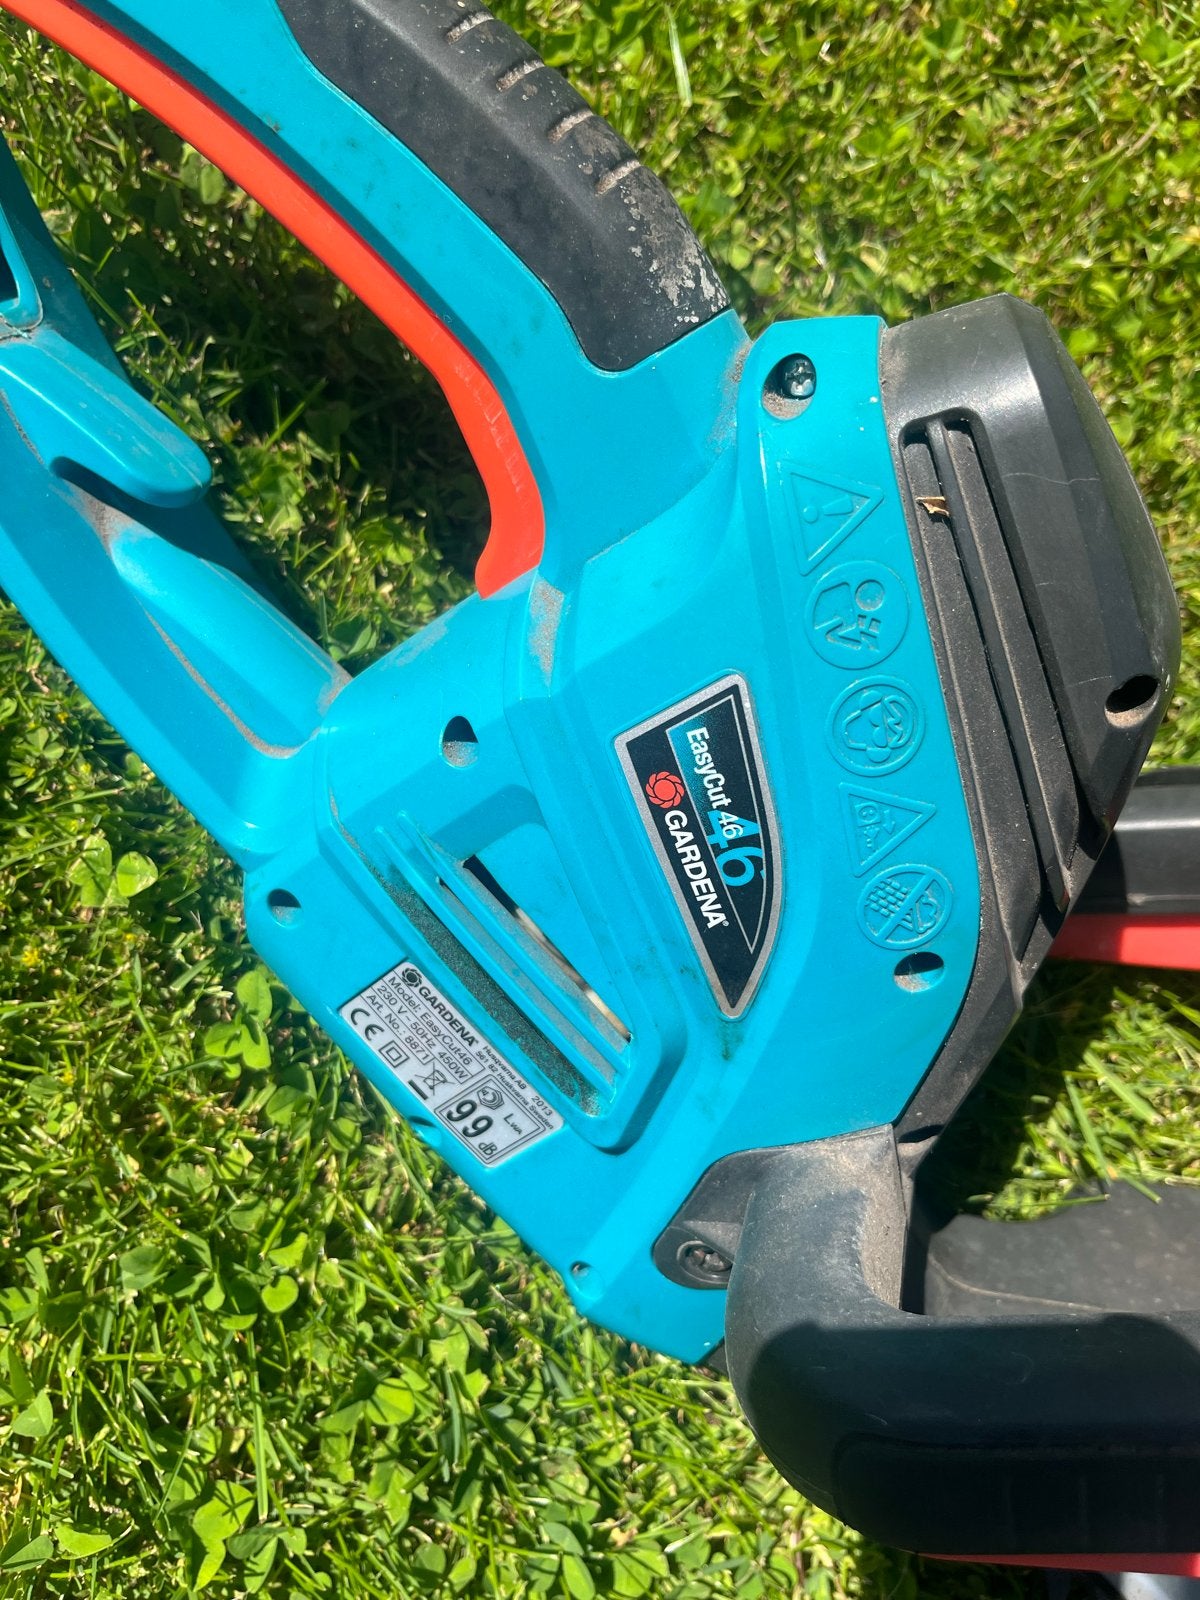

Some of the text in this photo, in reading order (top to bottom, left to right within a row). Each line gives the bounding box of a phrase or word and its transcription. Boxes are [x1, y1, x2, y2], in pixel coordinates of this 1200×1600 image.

[686, 726, 744, 839] EasyCut 46
[366, 994, 384, 1013] Art.
[404, 1035, 430, 1061] 8871
[377, 985, 398, 1006] 230
[438, 1051, 468, 1079] 450W
[388, 976, 473, 1066] Model: EasyCut46
[475, 1050, 489, 1063] 561
[488, 1063, 499, 1073] 82
[529, 1104, 554, 1130] Sweden
[515, 1079, 527, 1090] AB
[531, 1095, 553, 1117] 2013
[446, 1099, 498, 1156] 99 dB
